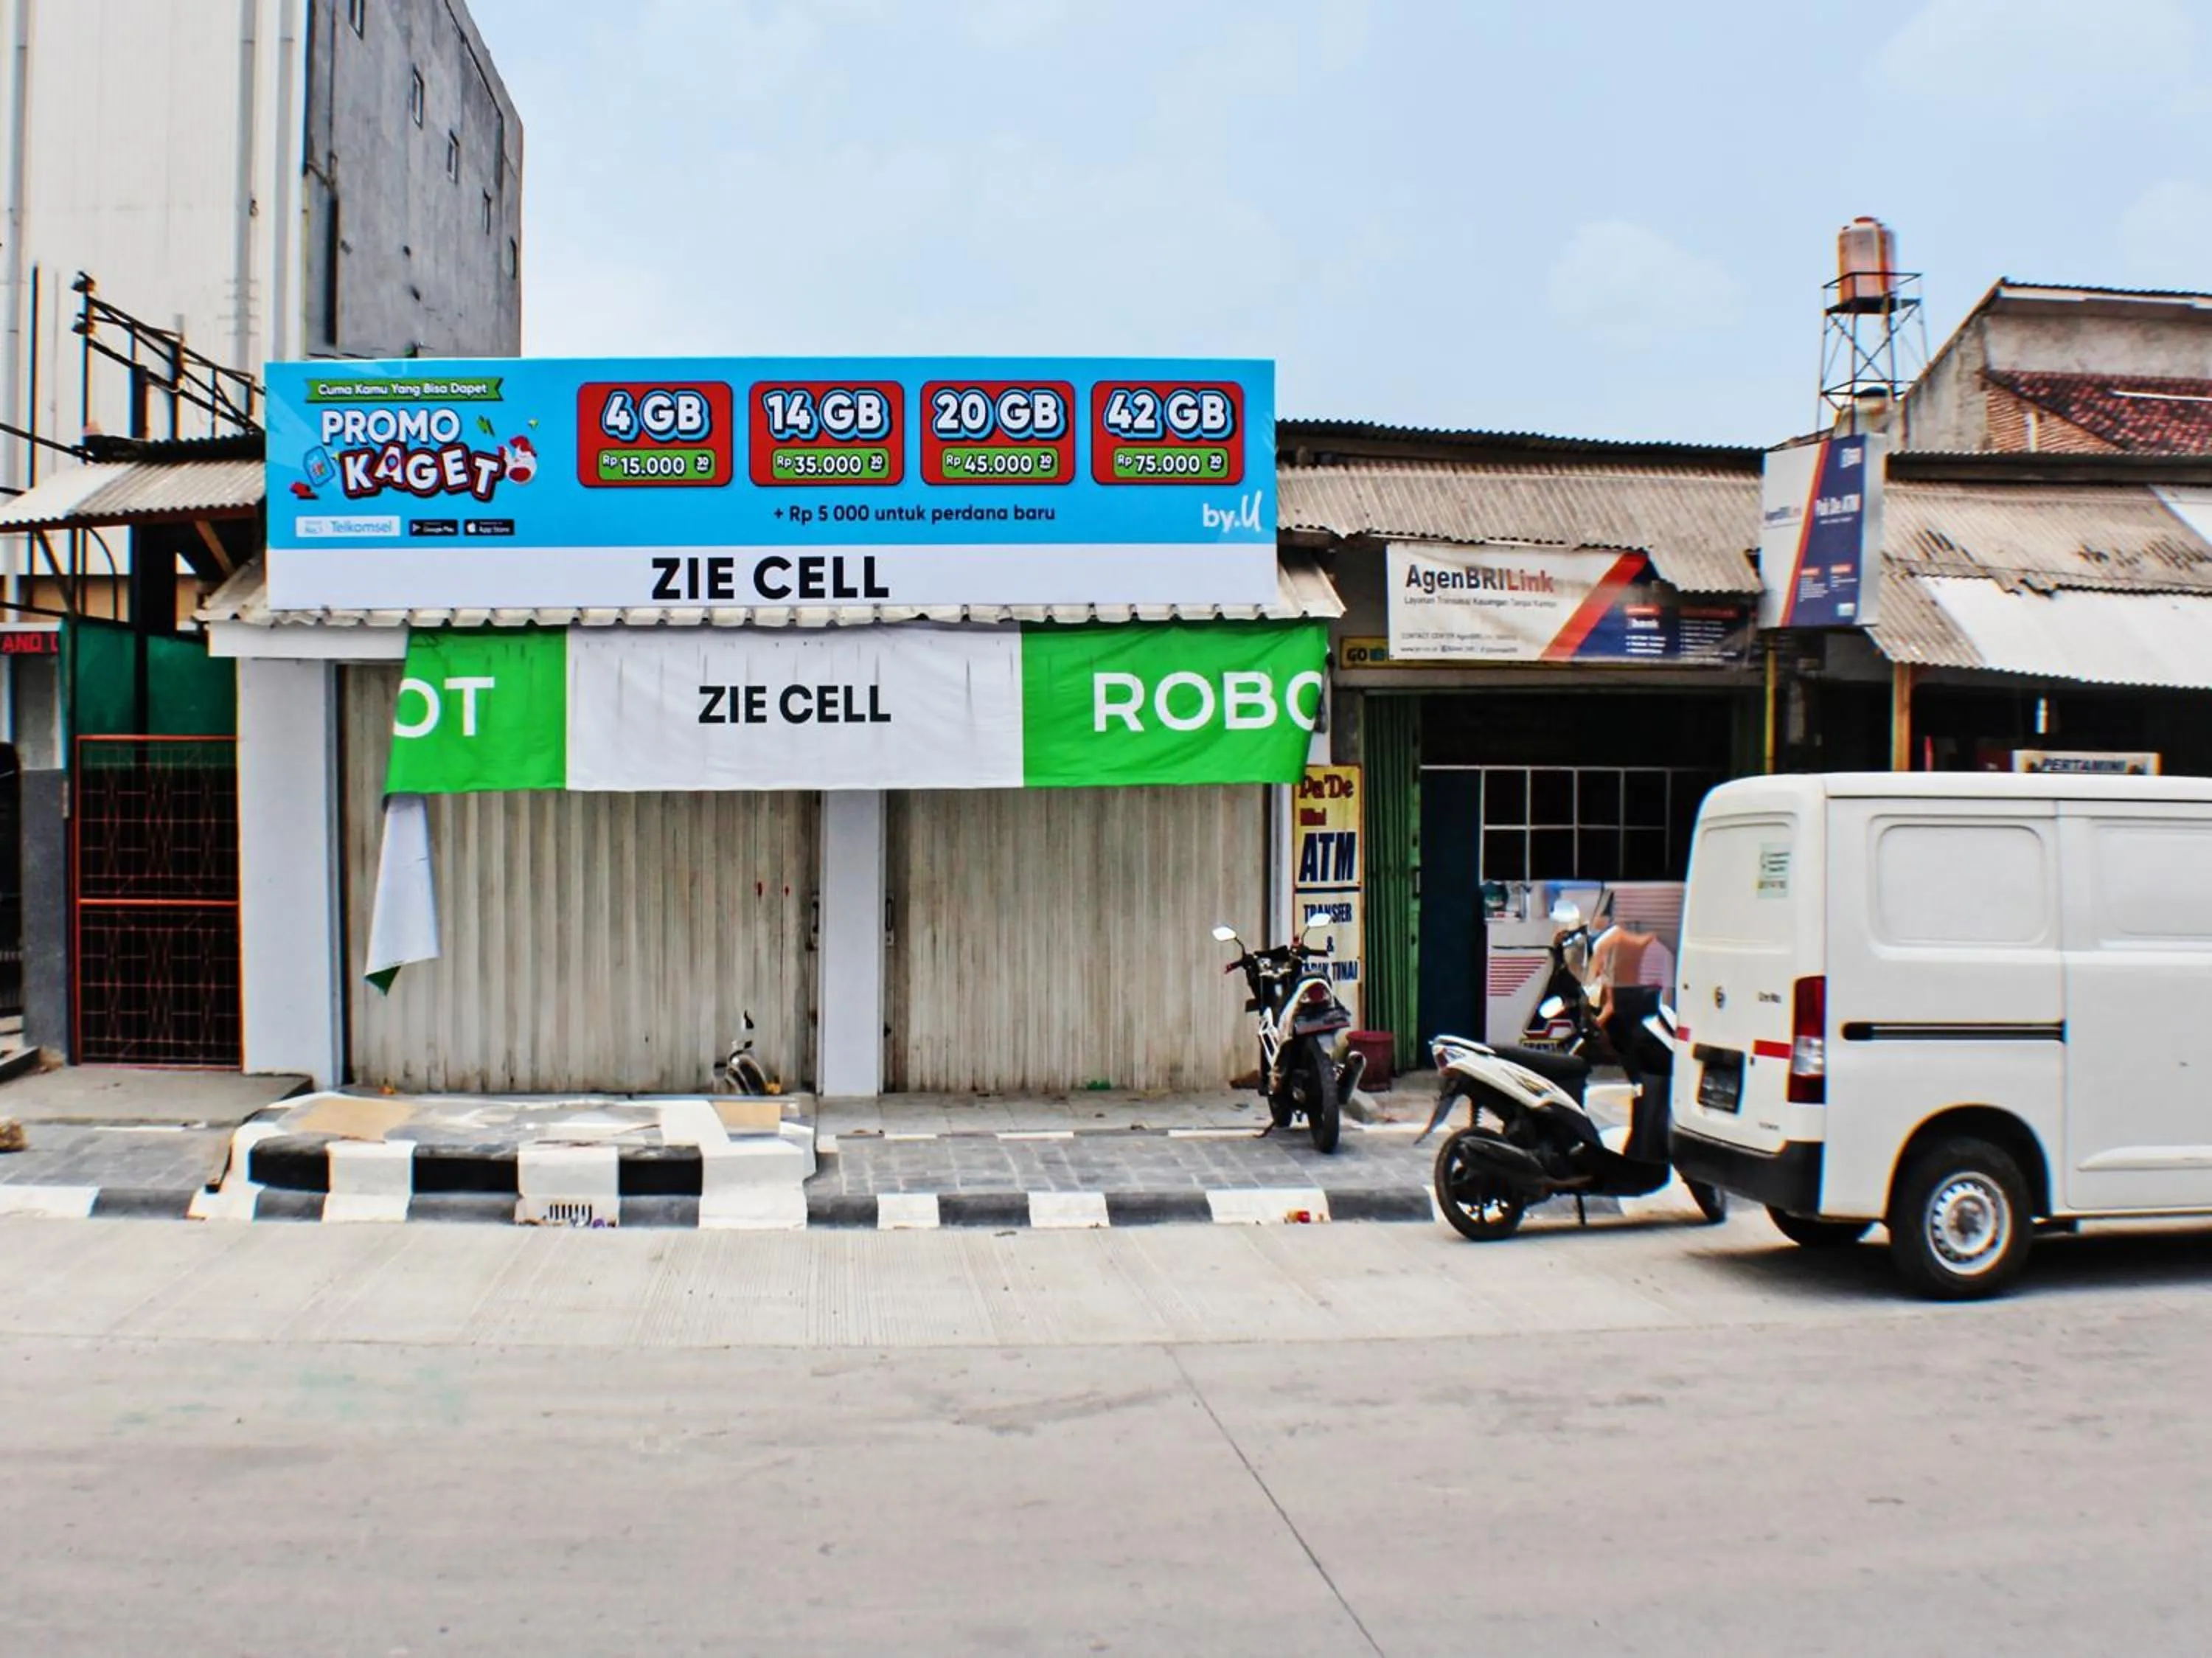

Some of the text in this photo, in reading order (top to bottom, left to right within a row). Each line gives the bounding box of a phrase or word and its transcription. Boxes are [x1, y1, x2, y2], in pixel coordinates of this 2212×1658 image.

[318, 382, 488, 397] Cuma Kamu Yang Bisa Dapet
[321, 409, 460, 443] PROMO
[605, 395, 703, 431] 4 GB
[767, 395, 883, 431] 14 GB
[936, 393, 1058, 431] 20 GB
[1107, 393, 1226, 431] 42 GB
[345, 445, 499, 495] KAGET
[602, 454, 685, 474] Rp 15.000
[776, 454, 861, 474] Rp 35.000
[946, 454, 1032, 473] Rp 45.000
[1117, 454, 1200, 473] Rp 75.000
[330, 519, 392, 533] Telkomsel
[789, 505, 812, 526] Rp
[874, 505, 926, 521] untuk
[931, 504, 1008, 525] perdana
[1014, 504, 1055, 521] baru
[652, 555, 889, 600] ZIE CELL
[1405, 564, 1555, 594] AgenBRILink
[393, 676, 495, 738] OT
[698, 684, 891, 724] ZIE CELL
[1298, 831, 1357, 882] ATM
